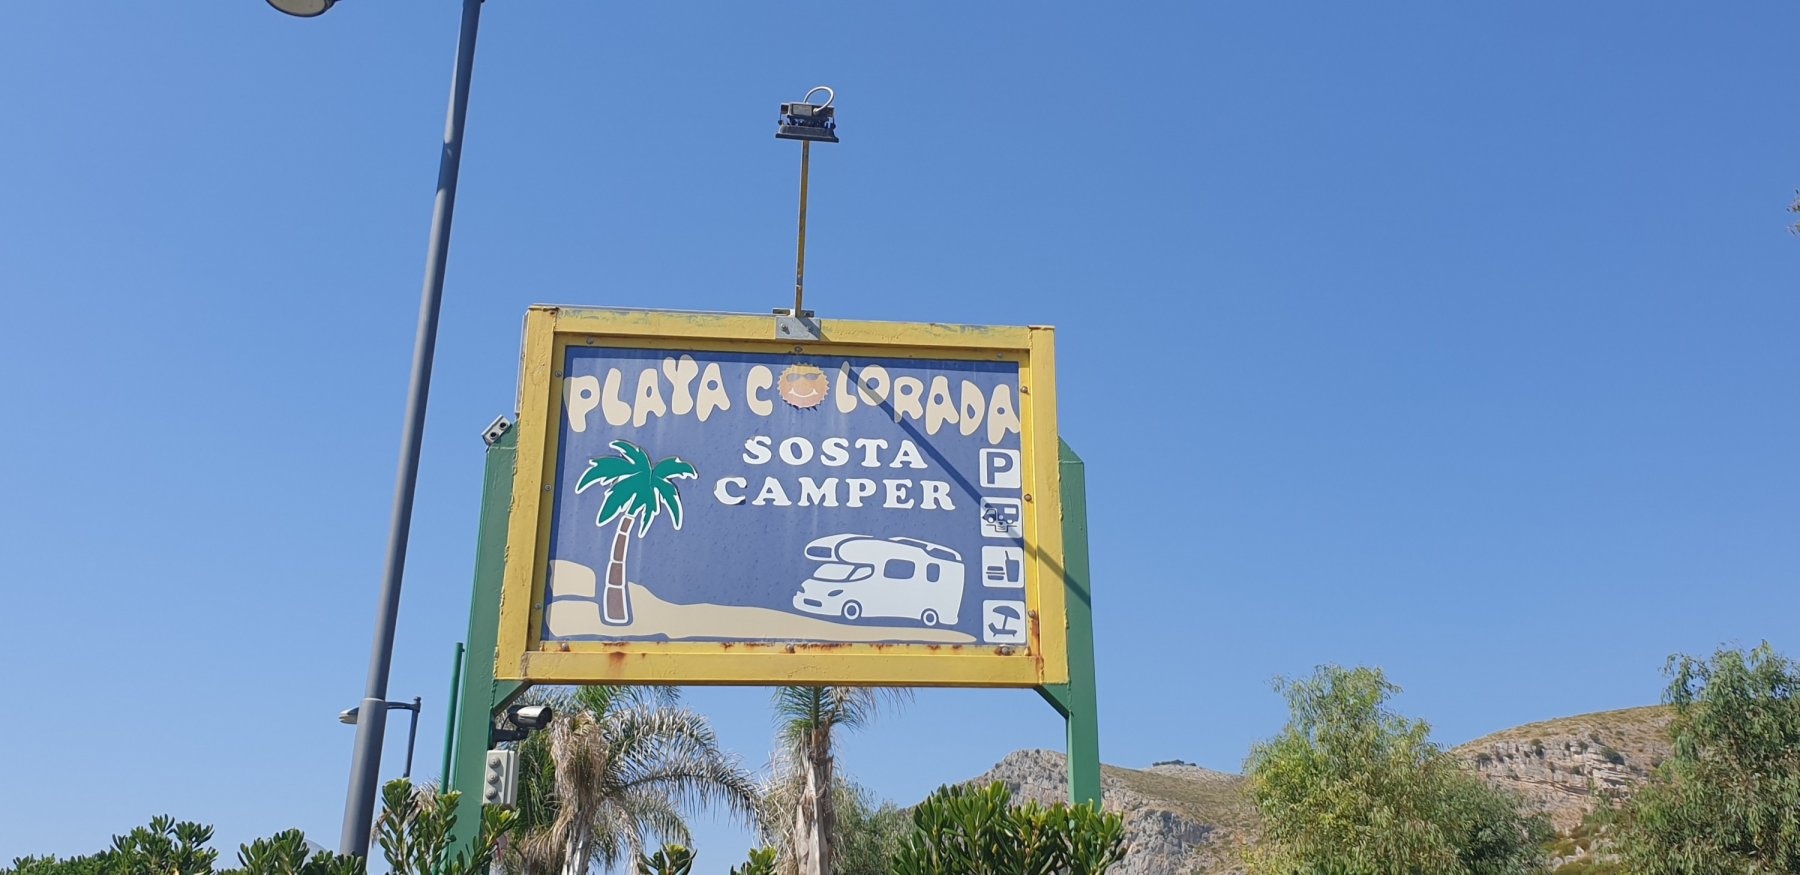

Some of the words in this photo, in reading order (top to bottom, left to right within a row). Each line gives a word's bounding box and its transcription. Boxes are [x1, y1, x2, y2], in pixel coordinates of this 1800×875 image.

[563, 354, 731, 433] PLAYA
[742, 435, 928, 469] SOSTA
[986, 451, 1014, 485] P
[713, 476, 956, 511] CAMPER
